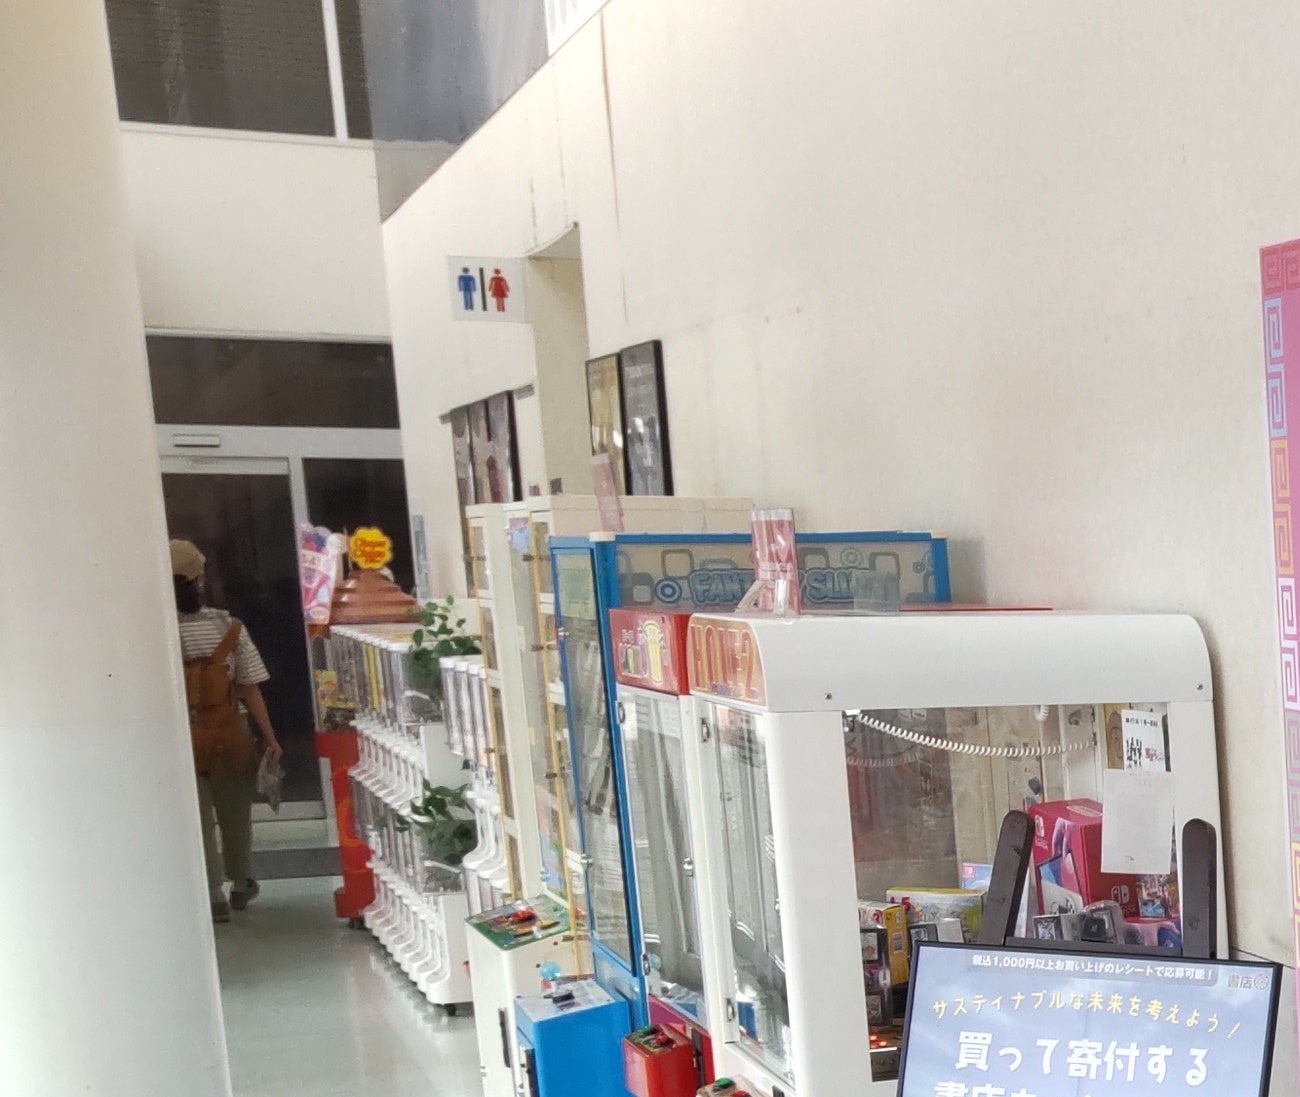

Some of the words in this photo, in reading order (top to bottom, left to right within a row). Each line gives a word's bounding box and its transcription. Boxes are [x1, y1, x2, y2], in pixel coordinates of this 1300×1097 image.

[955, 1031, 1210, 1086] 買って寄付する
